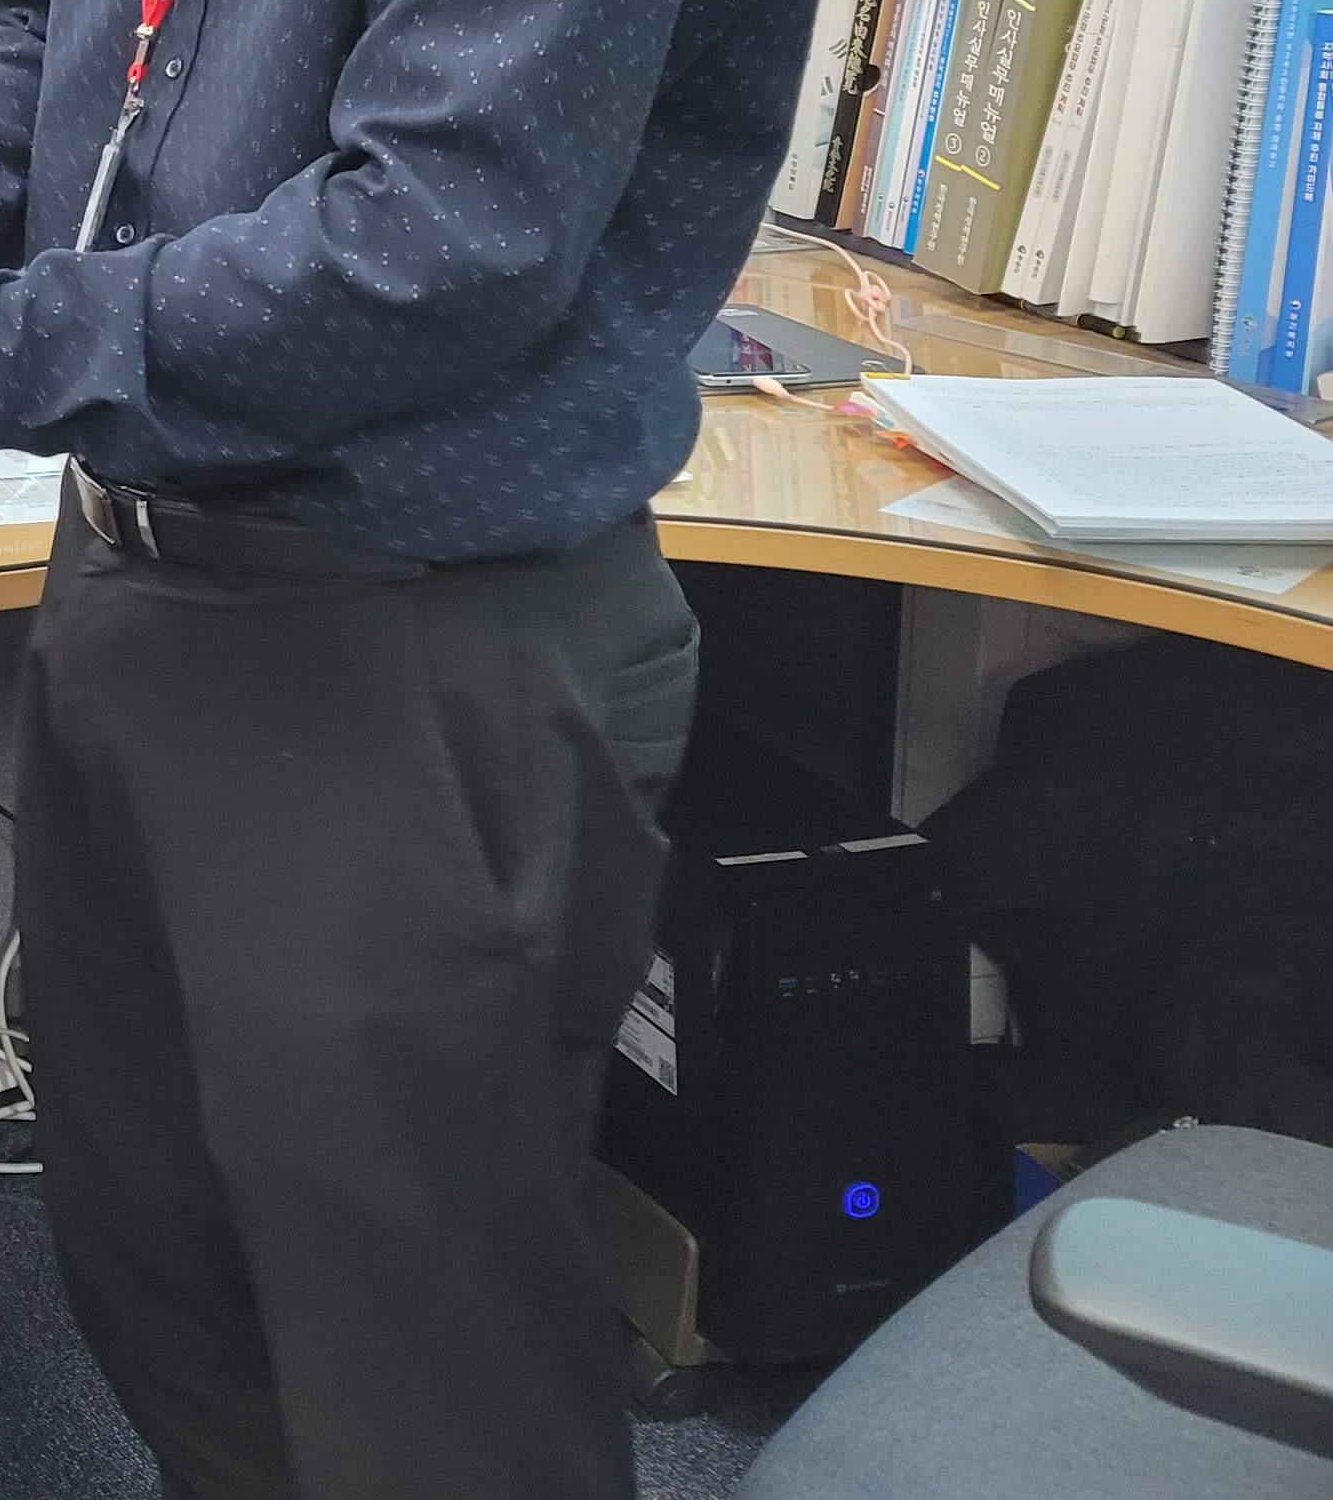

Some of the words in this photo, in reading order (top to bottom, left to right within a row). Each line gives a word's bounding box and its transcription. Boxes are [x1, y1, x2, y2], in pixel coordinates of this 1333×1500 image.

[952, 1, 992, 128] 인사실무매뉴얼
[979, 9, 1023, 145] 인사실무매뉴얼
[1285, 311, 1299, 358] 보건복지부
